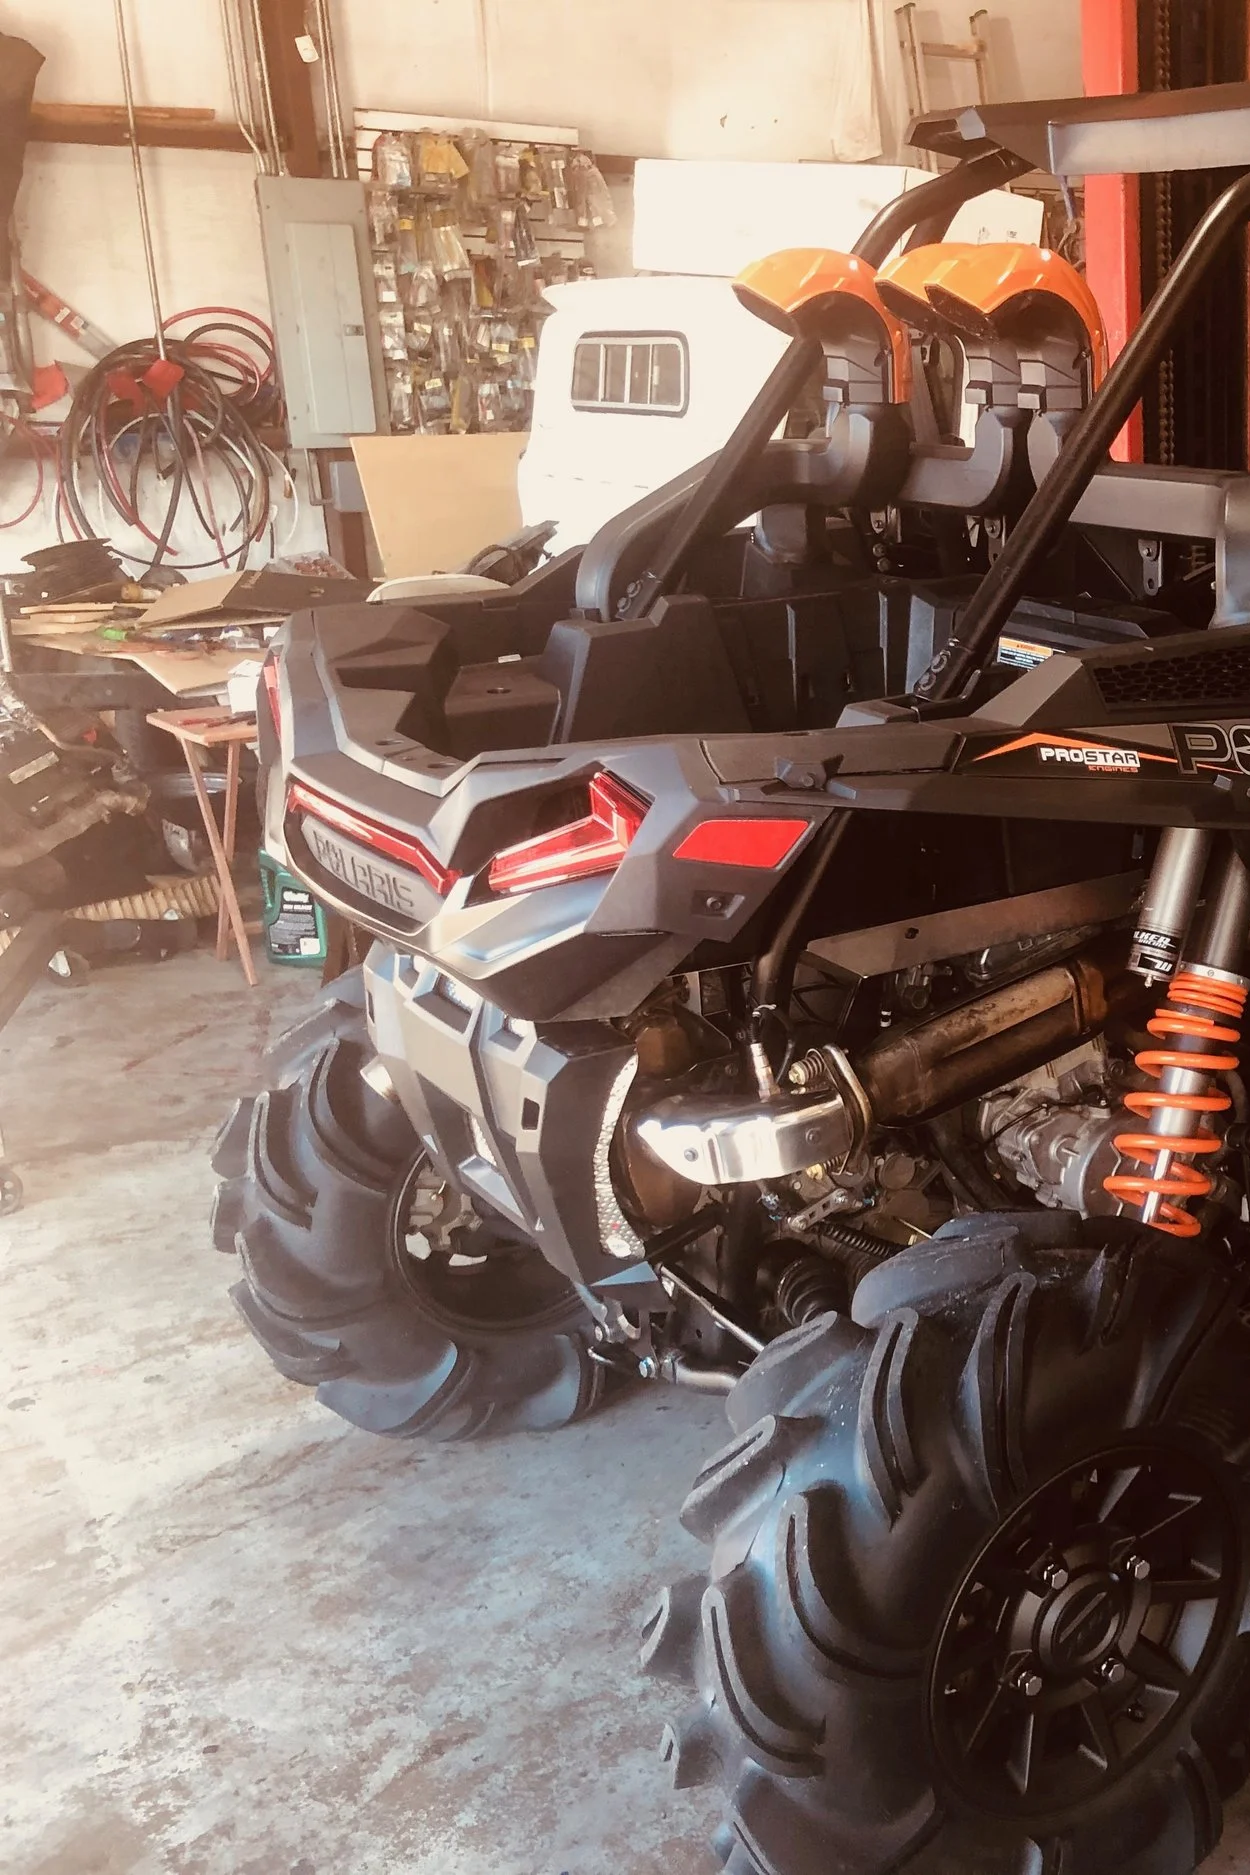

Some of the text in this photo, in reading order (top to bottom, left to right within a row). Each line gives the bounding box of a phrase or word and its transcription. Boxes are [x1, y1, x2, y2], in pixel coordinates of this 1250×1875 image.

[1040, 747, 1140, 767] PROSTAR
[1088, 765, 1138, 773] ENGINES
[312, 830, 416, 918] POLARIS
